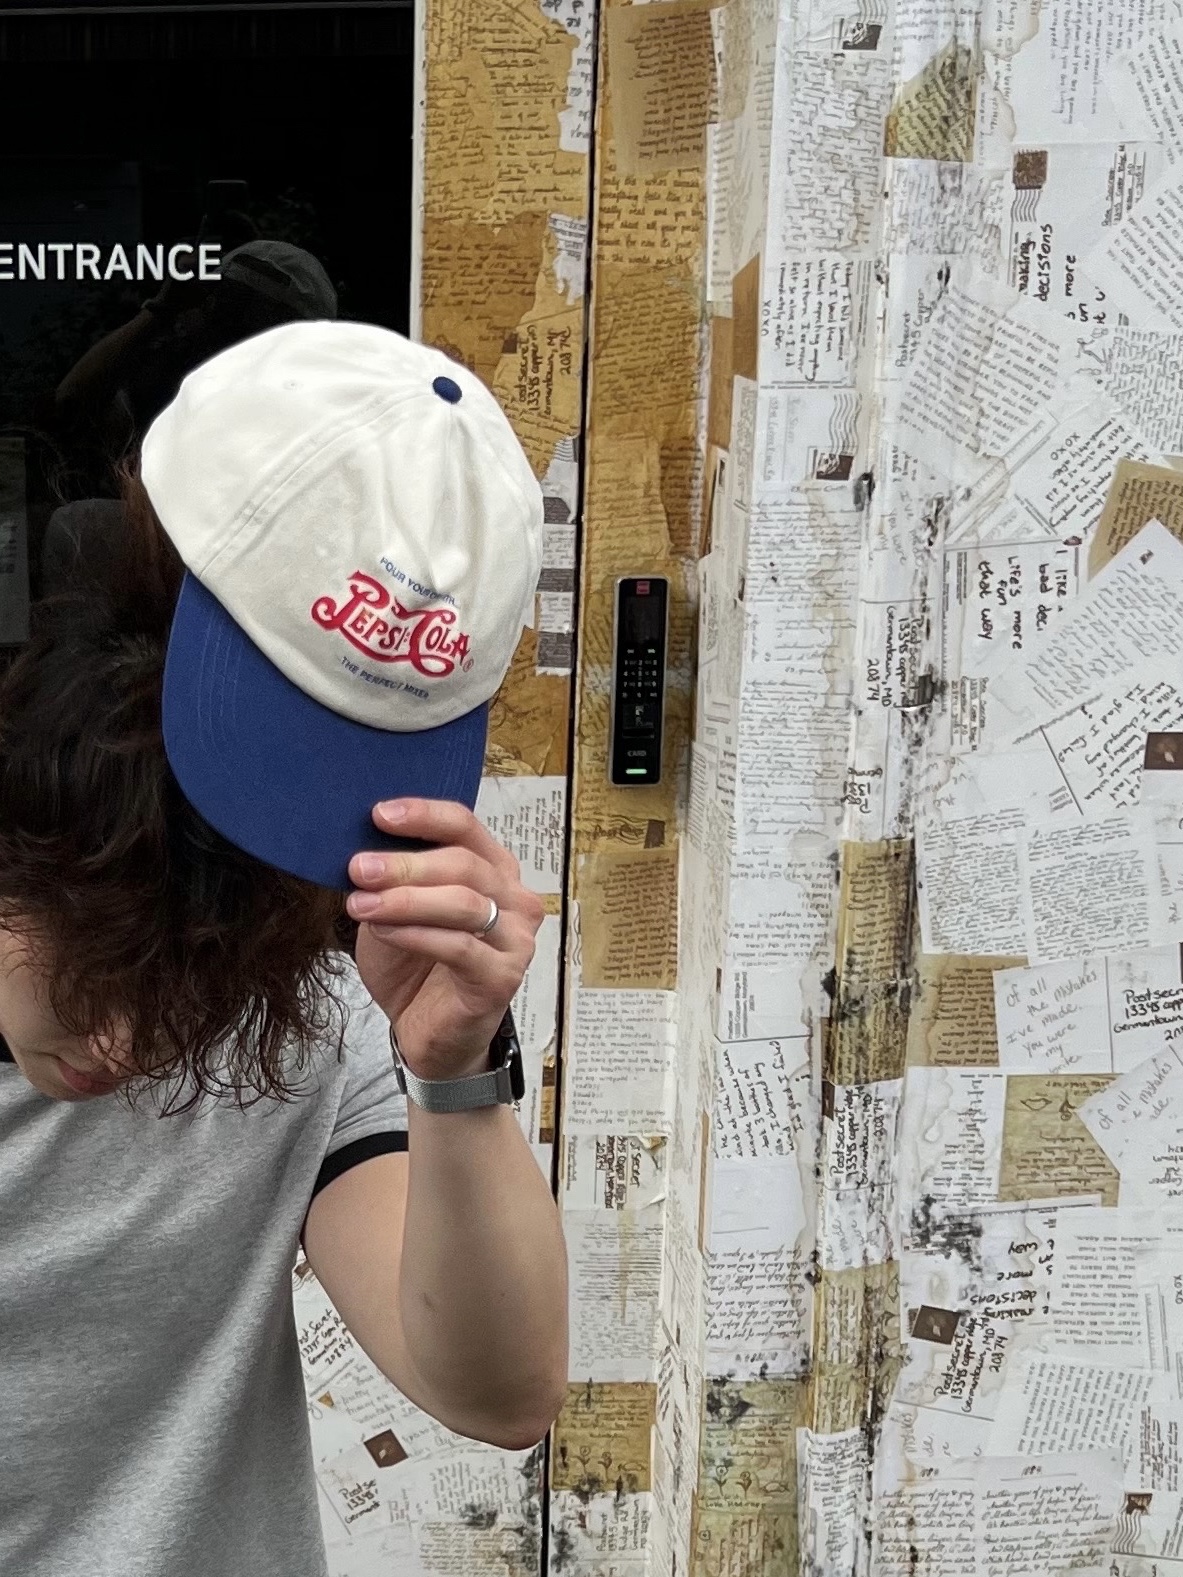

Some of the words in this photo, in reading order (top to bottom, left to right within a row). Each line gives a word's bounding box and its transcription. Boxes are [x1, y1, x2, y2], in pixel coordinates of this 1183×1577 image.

[1032, 222, 1054, 303] decisions
[1064, 254, 1077, 298] more
[977, 608, 994, 640] way
[1011, 610, 1023, 650] more
[340, 656, 360, 675] THE
[359, 669, 405, 691] PERFECT
[867, 658, 881, 701] 20874
[1028, 976, 1048, 998] all
[1046, 1022, 1078, 1044] were
